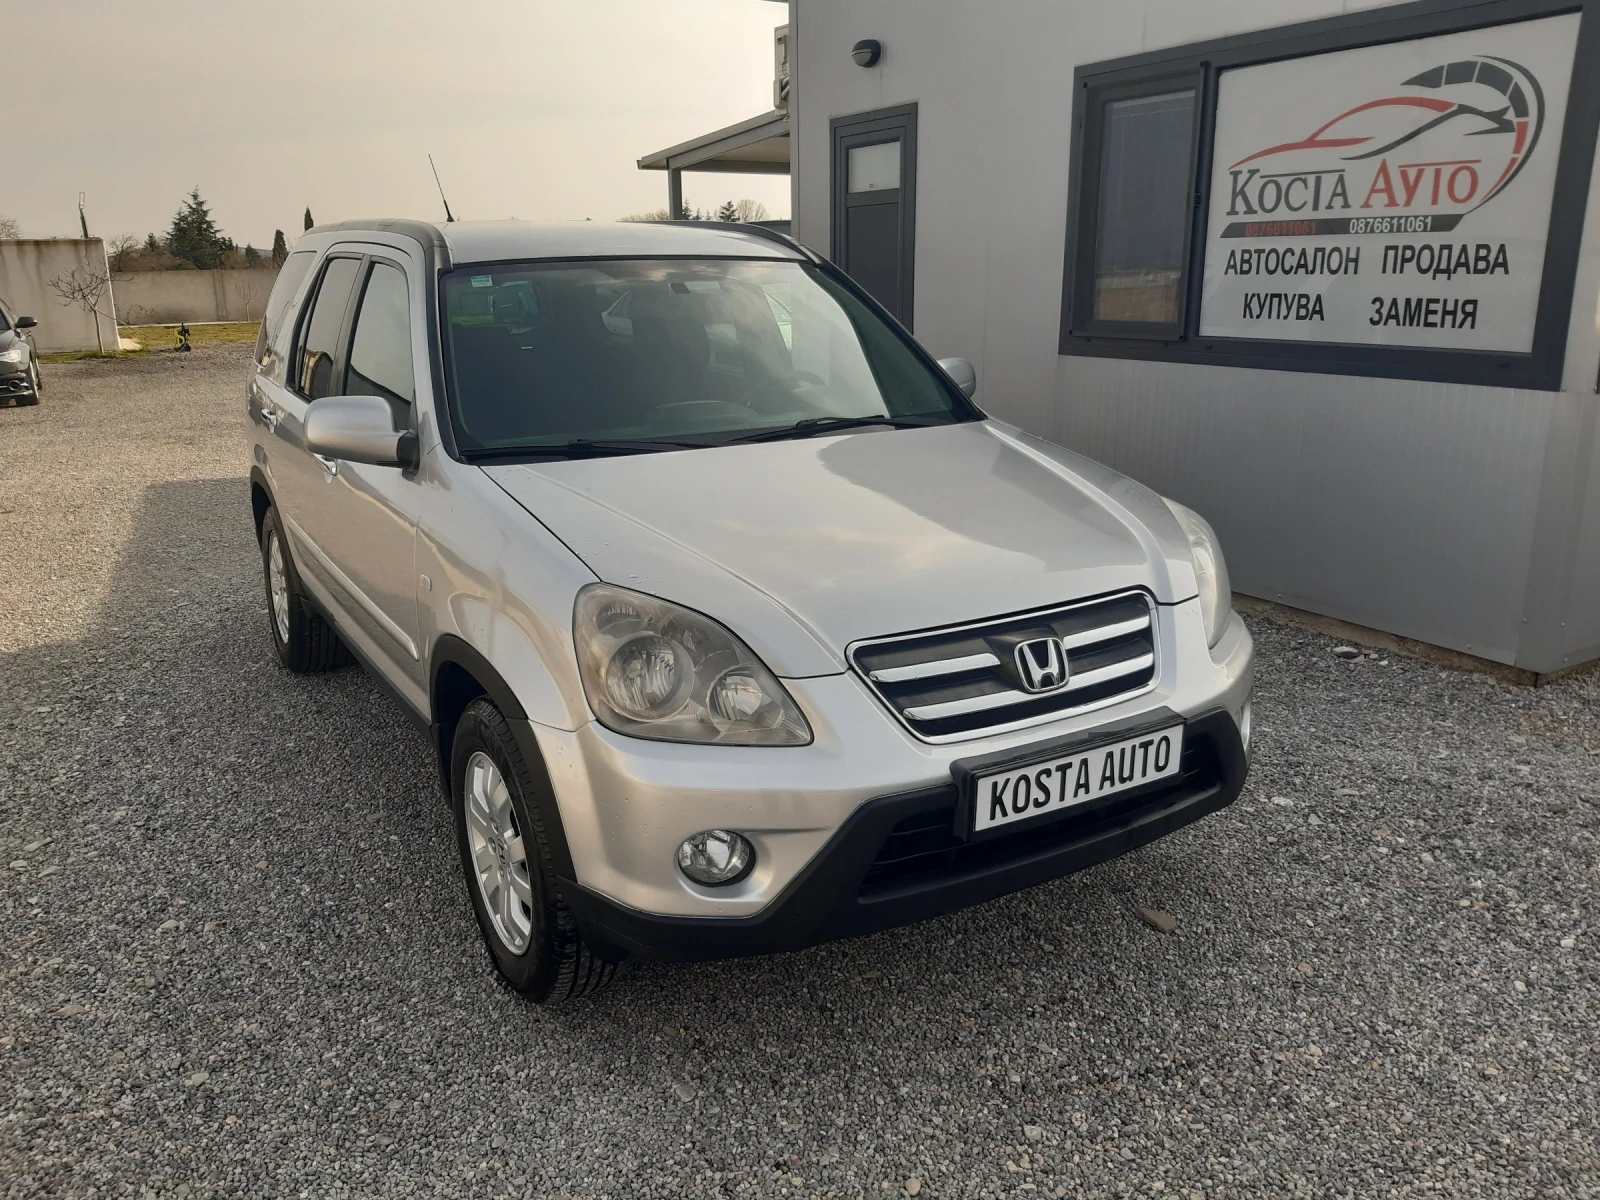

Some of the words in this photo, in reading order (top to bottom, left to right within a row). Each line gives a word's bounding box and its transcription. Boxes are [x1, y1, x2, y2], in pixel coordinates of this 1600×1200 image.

[1350, 216, 1432, 234] 0876611061
[1224, 246, 1360, 275] АВТОСАЛОН
[1381, 244, 1510, 280] ПРОДАВА
[1243, 293, 1325, 321] КУПУВА
[1369, 297, 1478, 329] ЗАМЕНЯ
[989, 757, 1090, 821] KOSTA
[1098, 735, 1171, 791] AUTO
